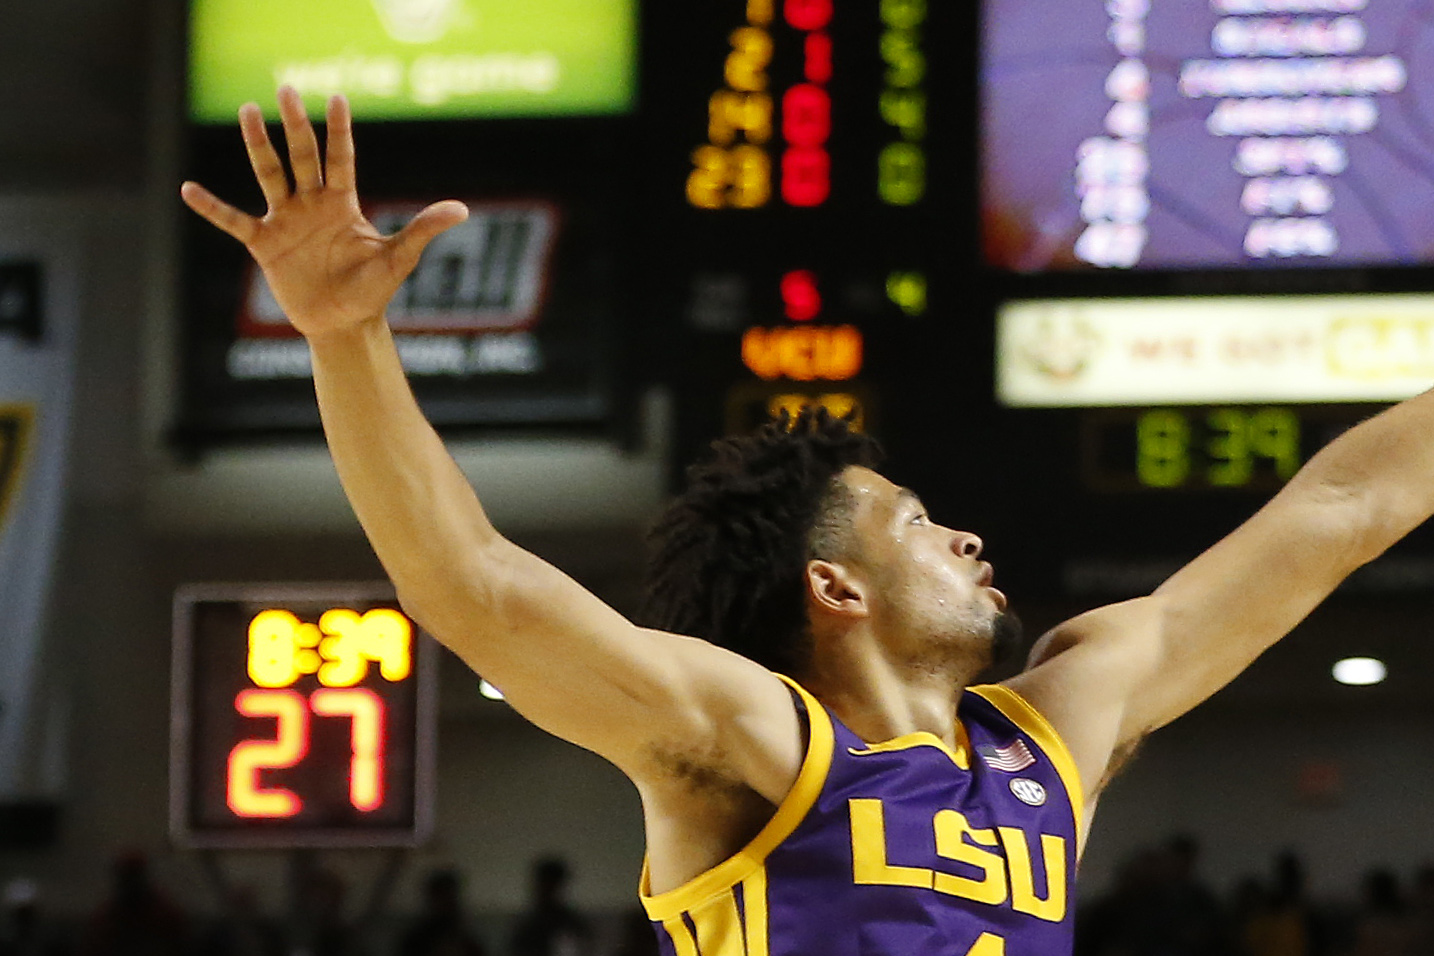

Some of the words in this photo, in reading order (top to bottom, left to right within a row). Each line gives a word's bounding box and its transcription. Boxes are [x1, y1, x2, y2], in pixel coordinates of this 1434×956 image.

[741, 324, 863, 381] VCU
[1136, 407, 1299, 488] 8:39
[247, 609, 412, 688] 8:39
[227, 690, 386, 818] 27
[848, 798, 1067, 923] LSU
